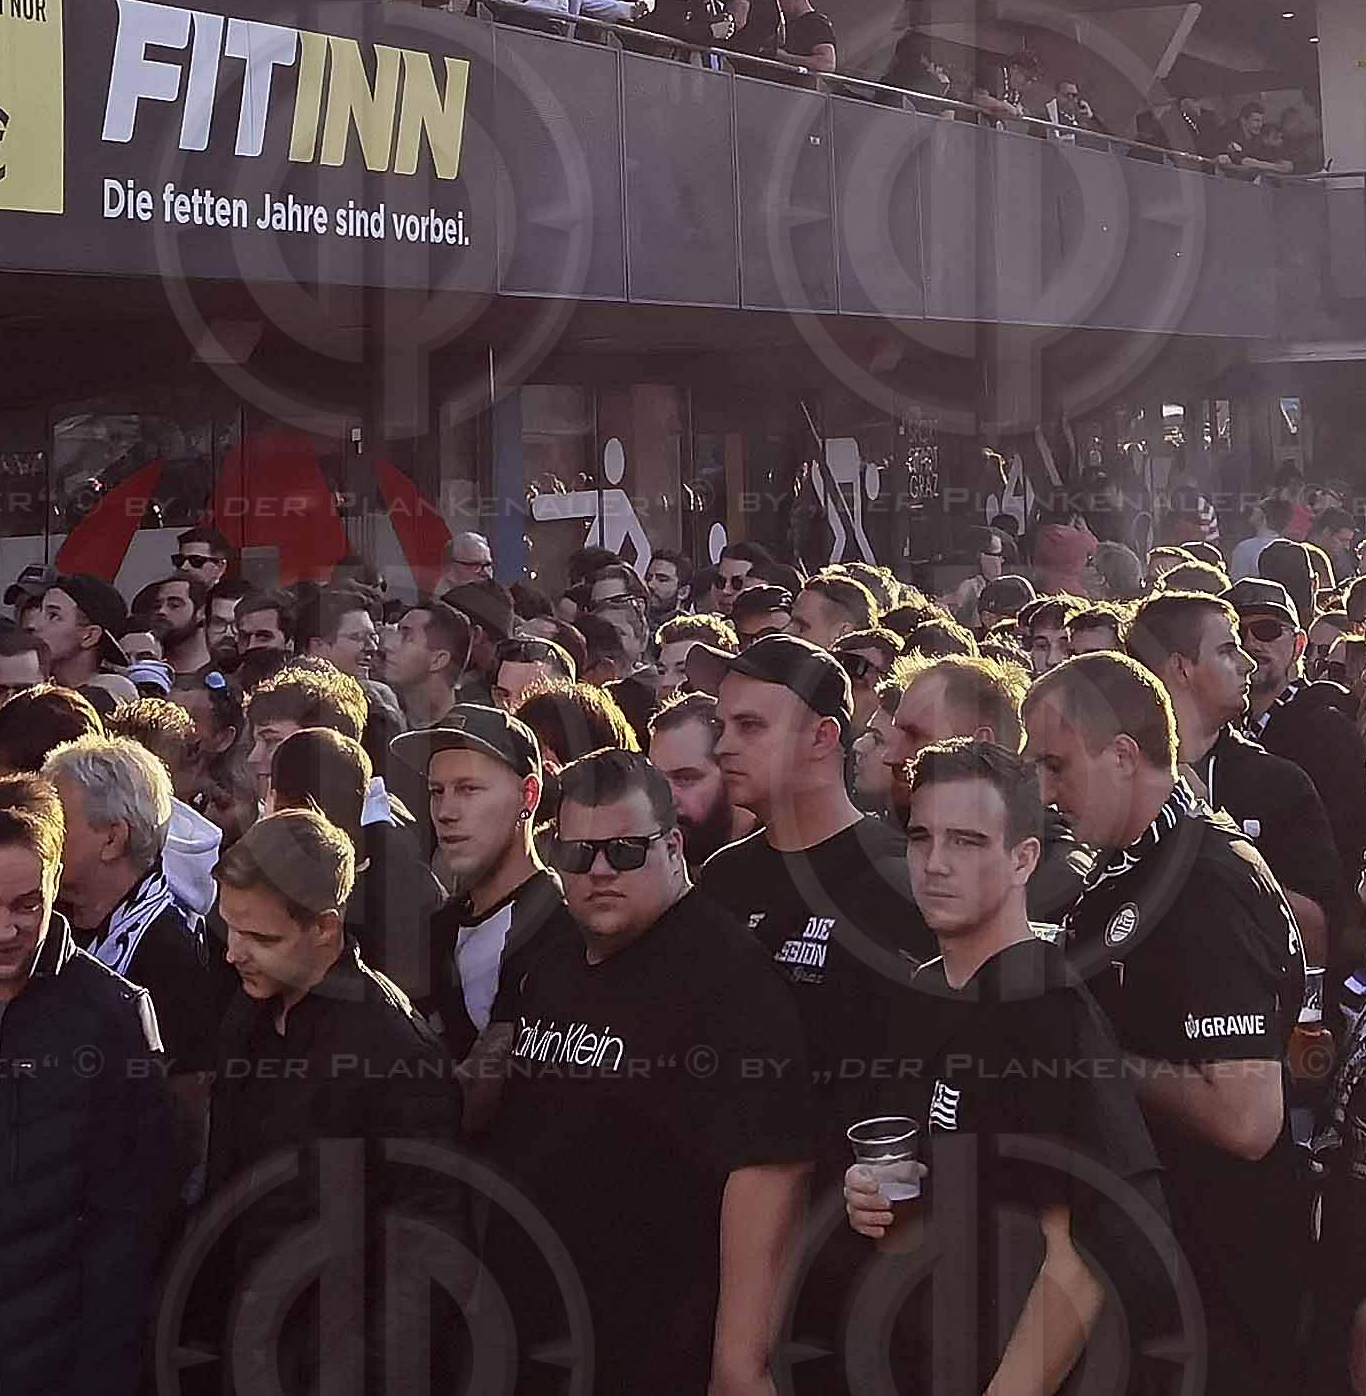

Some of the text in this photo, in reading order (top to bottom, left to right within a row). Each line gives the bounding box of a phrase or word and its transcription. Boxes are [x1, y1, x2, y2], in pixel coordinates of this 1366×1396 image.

[102, 178, 471, 247] Die fetten Jahre sind vorbei.
[558, 1022, 624, 1072] Klein
[1201, 1015, 1266, 1038] GRAWE
